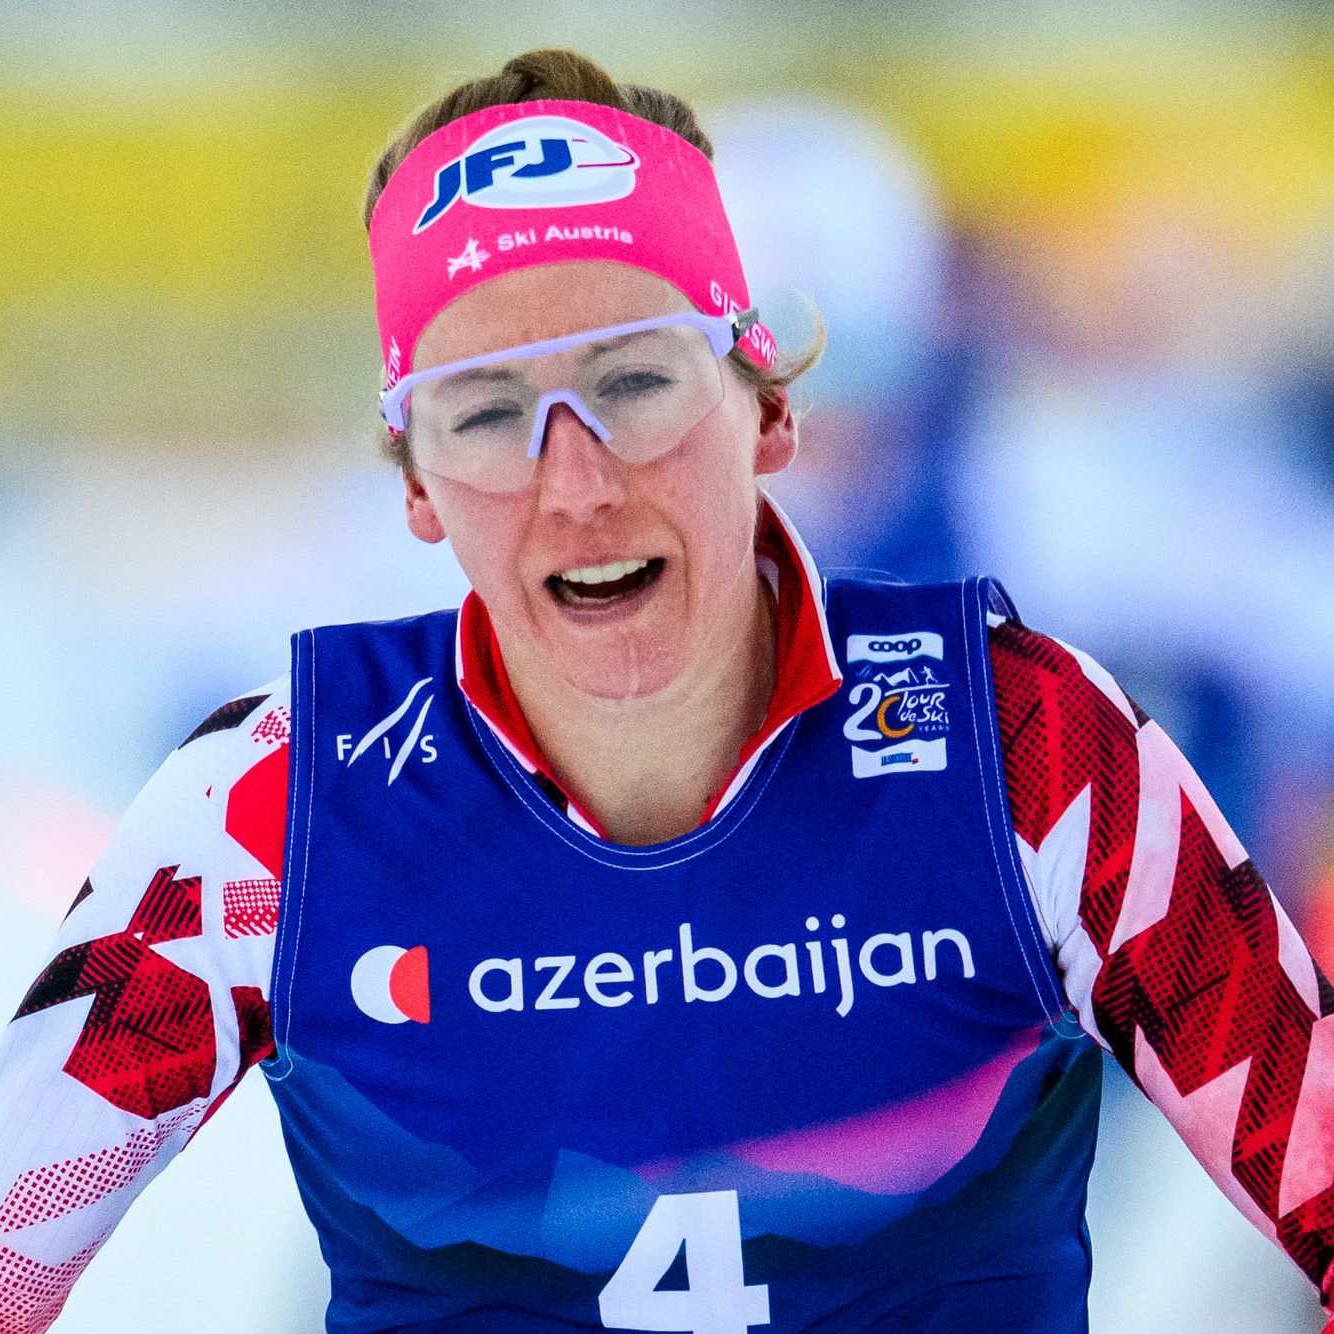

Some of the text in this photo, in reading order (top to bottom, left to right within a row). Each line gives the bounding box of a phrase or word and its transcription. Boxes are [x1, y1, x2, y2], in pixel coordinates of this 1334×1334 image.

[416, 138, 573, 230] JFJ
[497, 225, 634, 251] Ski Austria
[868, 638, 922, 655] coop
[918, 724, 950, 732] YEARS
[468, 914, 976, 1017] azerbaijan
